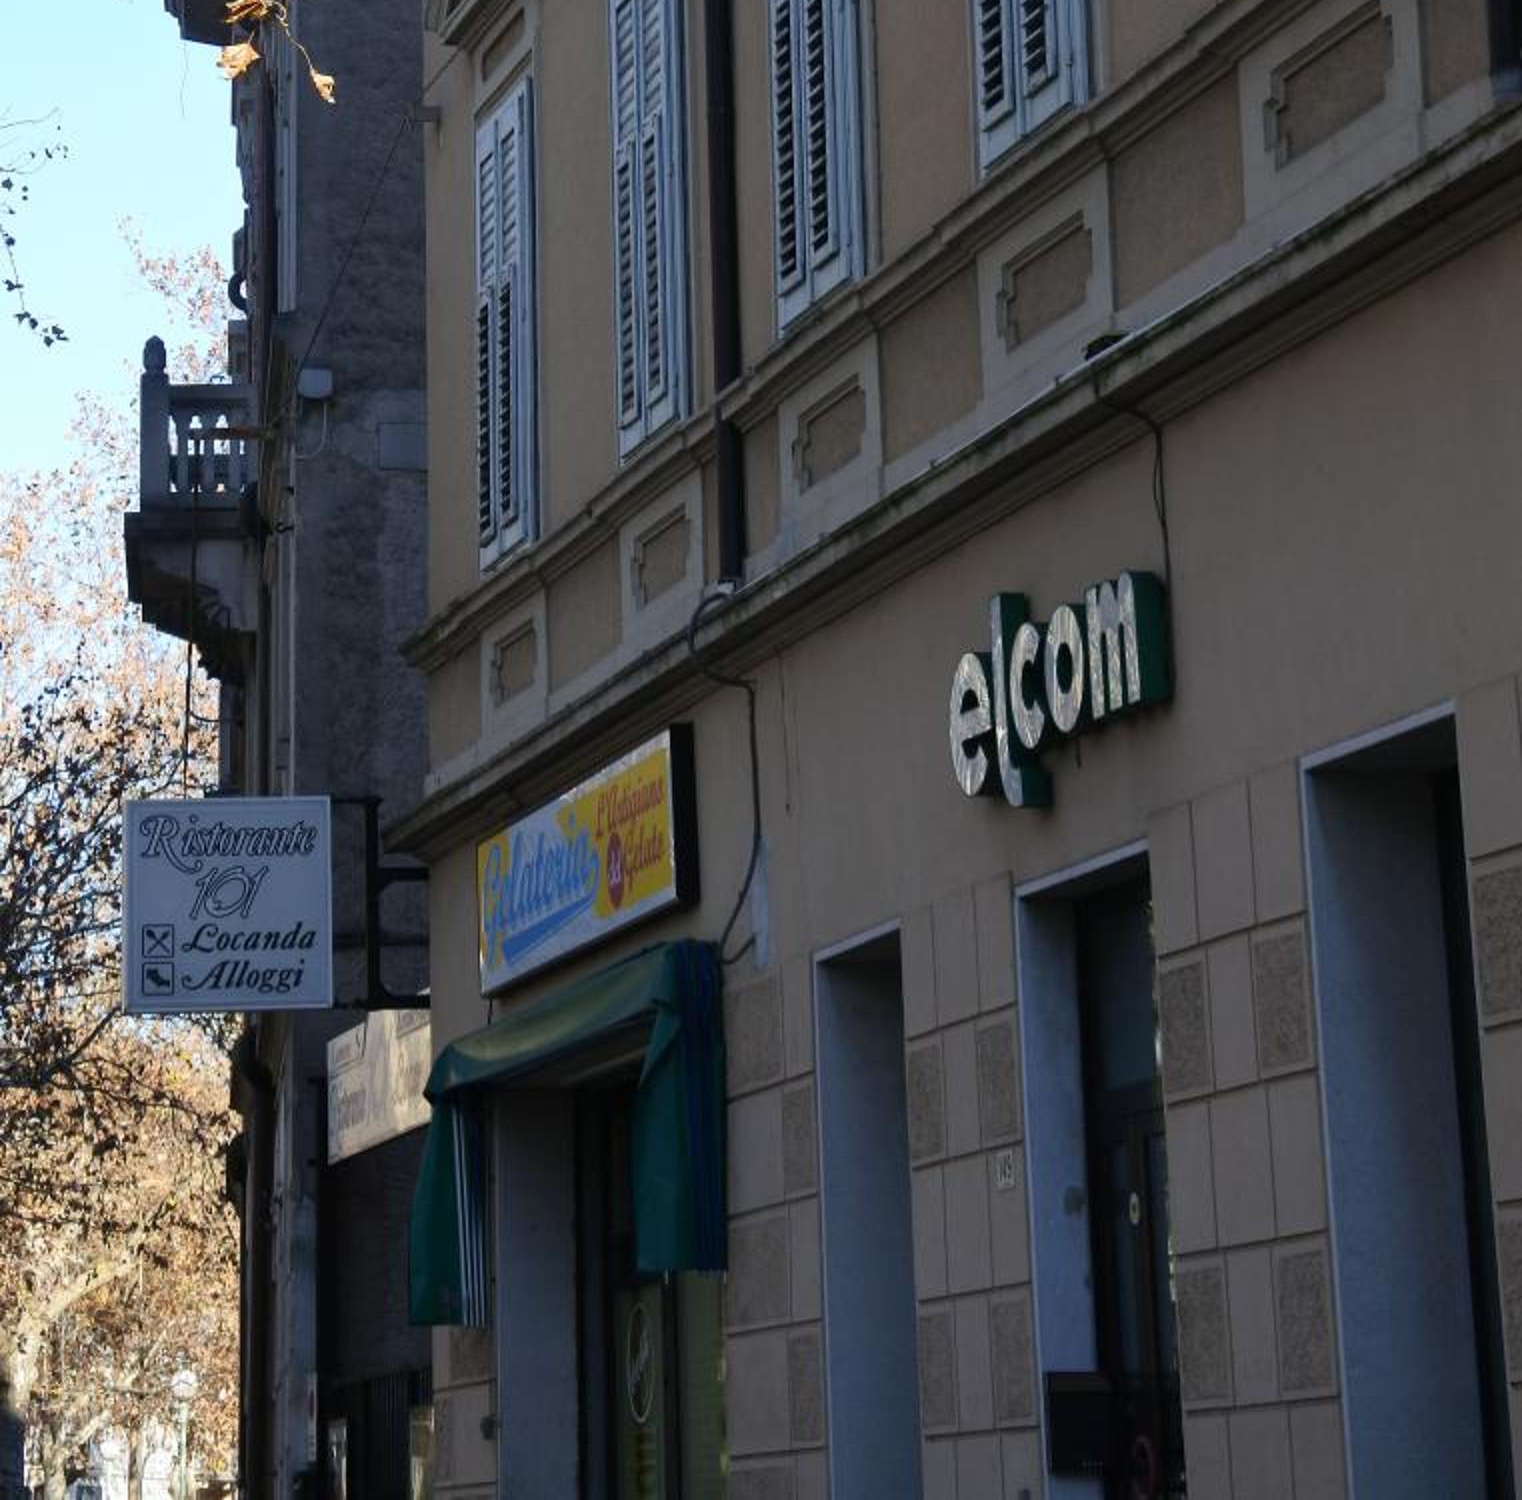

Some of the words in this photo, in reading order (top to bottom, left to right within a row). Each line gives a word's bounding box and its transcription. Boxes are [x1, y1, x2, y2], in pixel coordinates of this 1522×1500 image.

[950, 571, 1141, 806] elcom
[139, 814, 319, 874] Ristorante
[483, 812, 600, 965] Gelateria
[182, 921, 316, 953] Locanda
[181, 959, 305, 994] Alloggi
